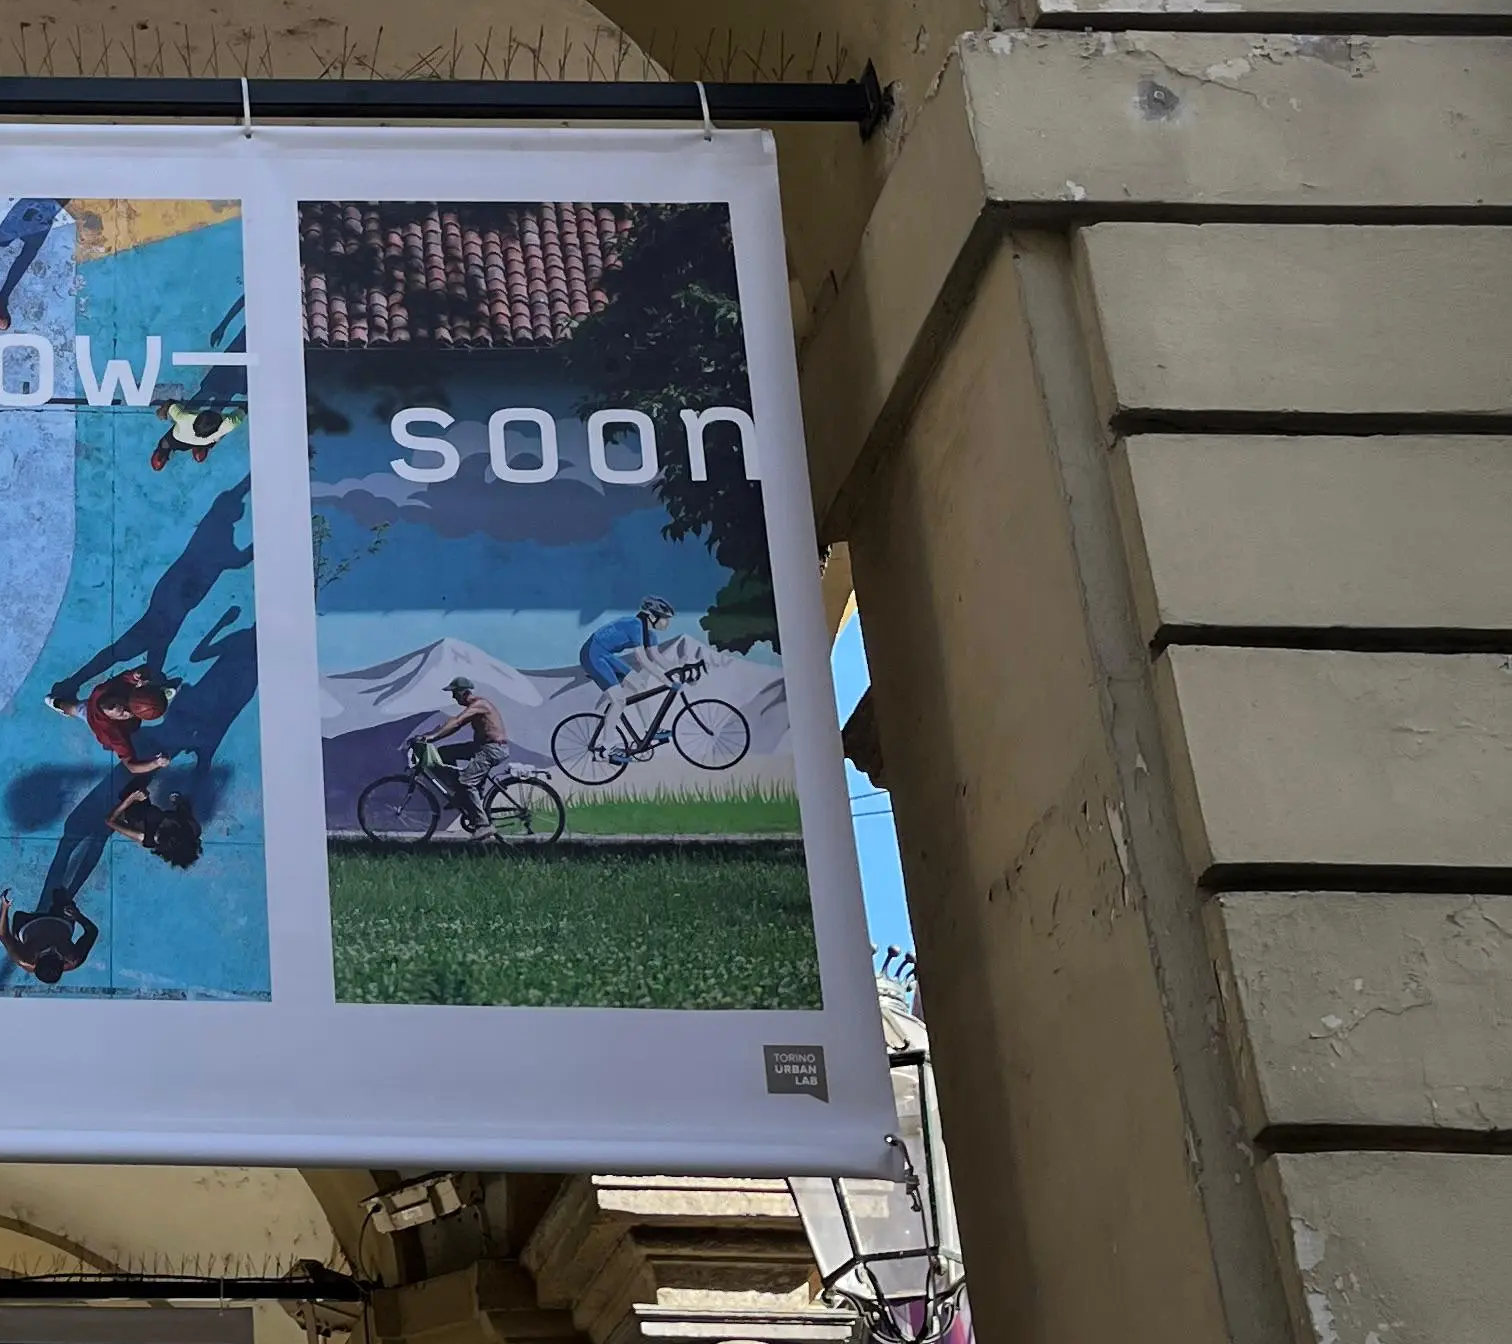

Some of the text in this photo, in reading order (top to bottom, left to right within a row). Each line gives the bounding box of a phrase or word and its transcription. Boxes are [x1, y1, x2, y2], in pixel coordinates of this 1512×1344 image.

[389, 405, 761, 485] soon
[774, 1053, 816, 1063] TORINO
[774, 1065, 817, 1074] URBAN
[795, 1076, 818, 1086] LAB
